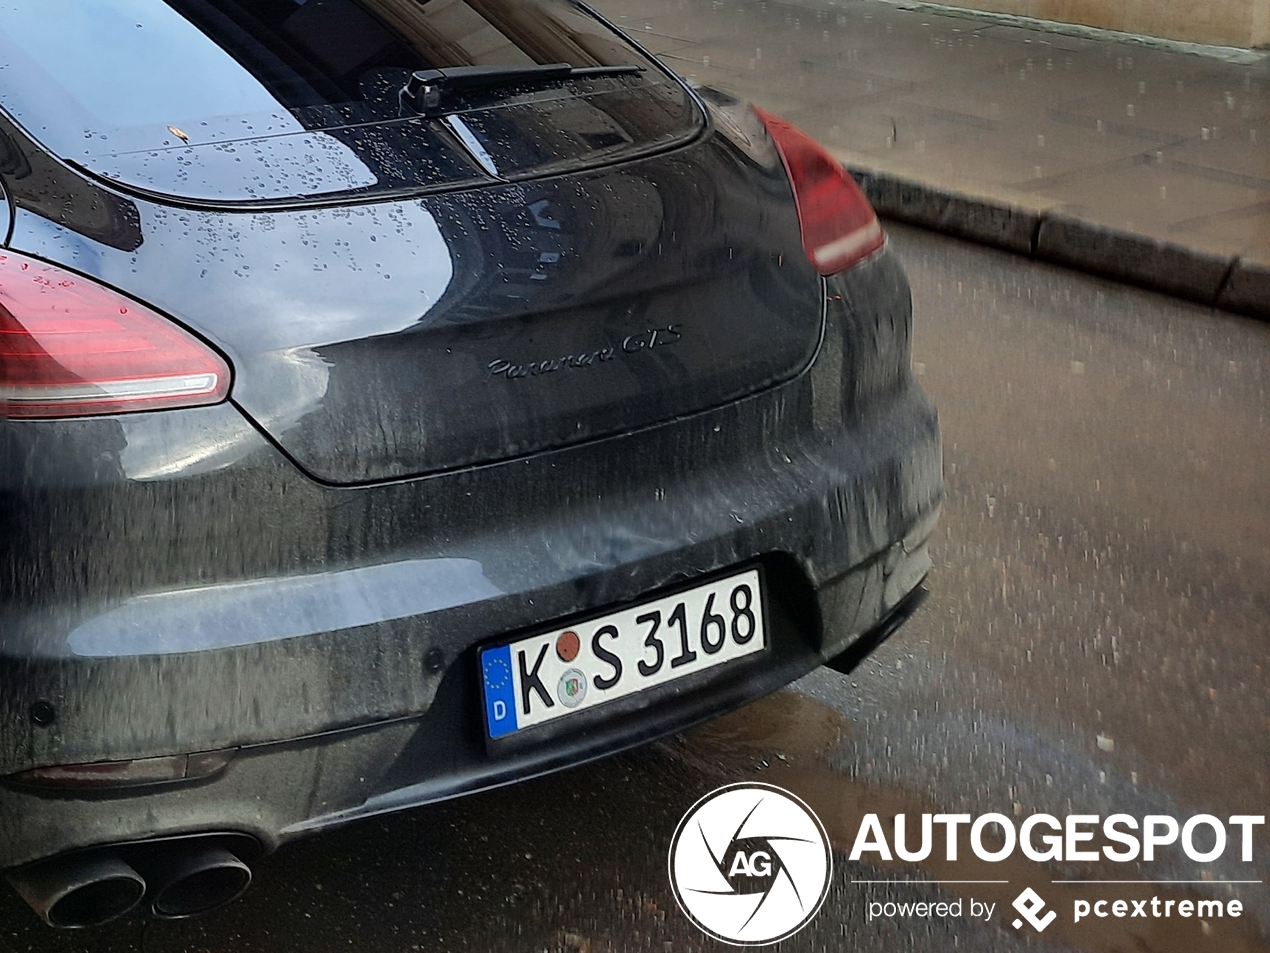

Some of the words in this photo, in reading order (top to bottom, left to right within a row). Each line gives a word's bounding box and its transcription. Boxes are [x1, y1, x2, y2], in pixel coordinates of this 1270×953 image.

[622, 323, 682, 354] GTS
[635, 584, 756, 678] 3168
[493, 700, 507, 721] D
